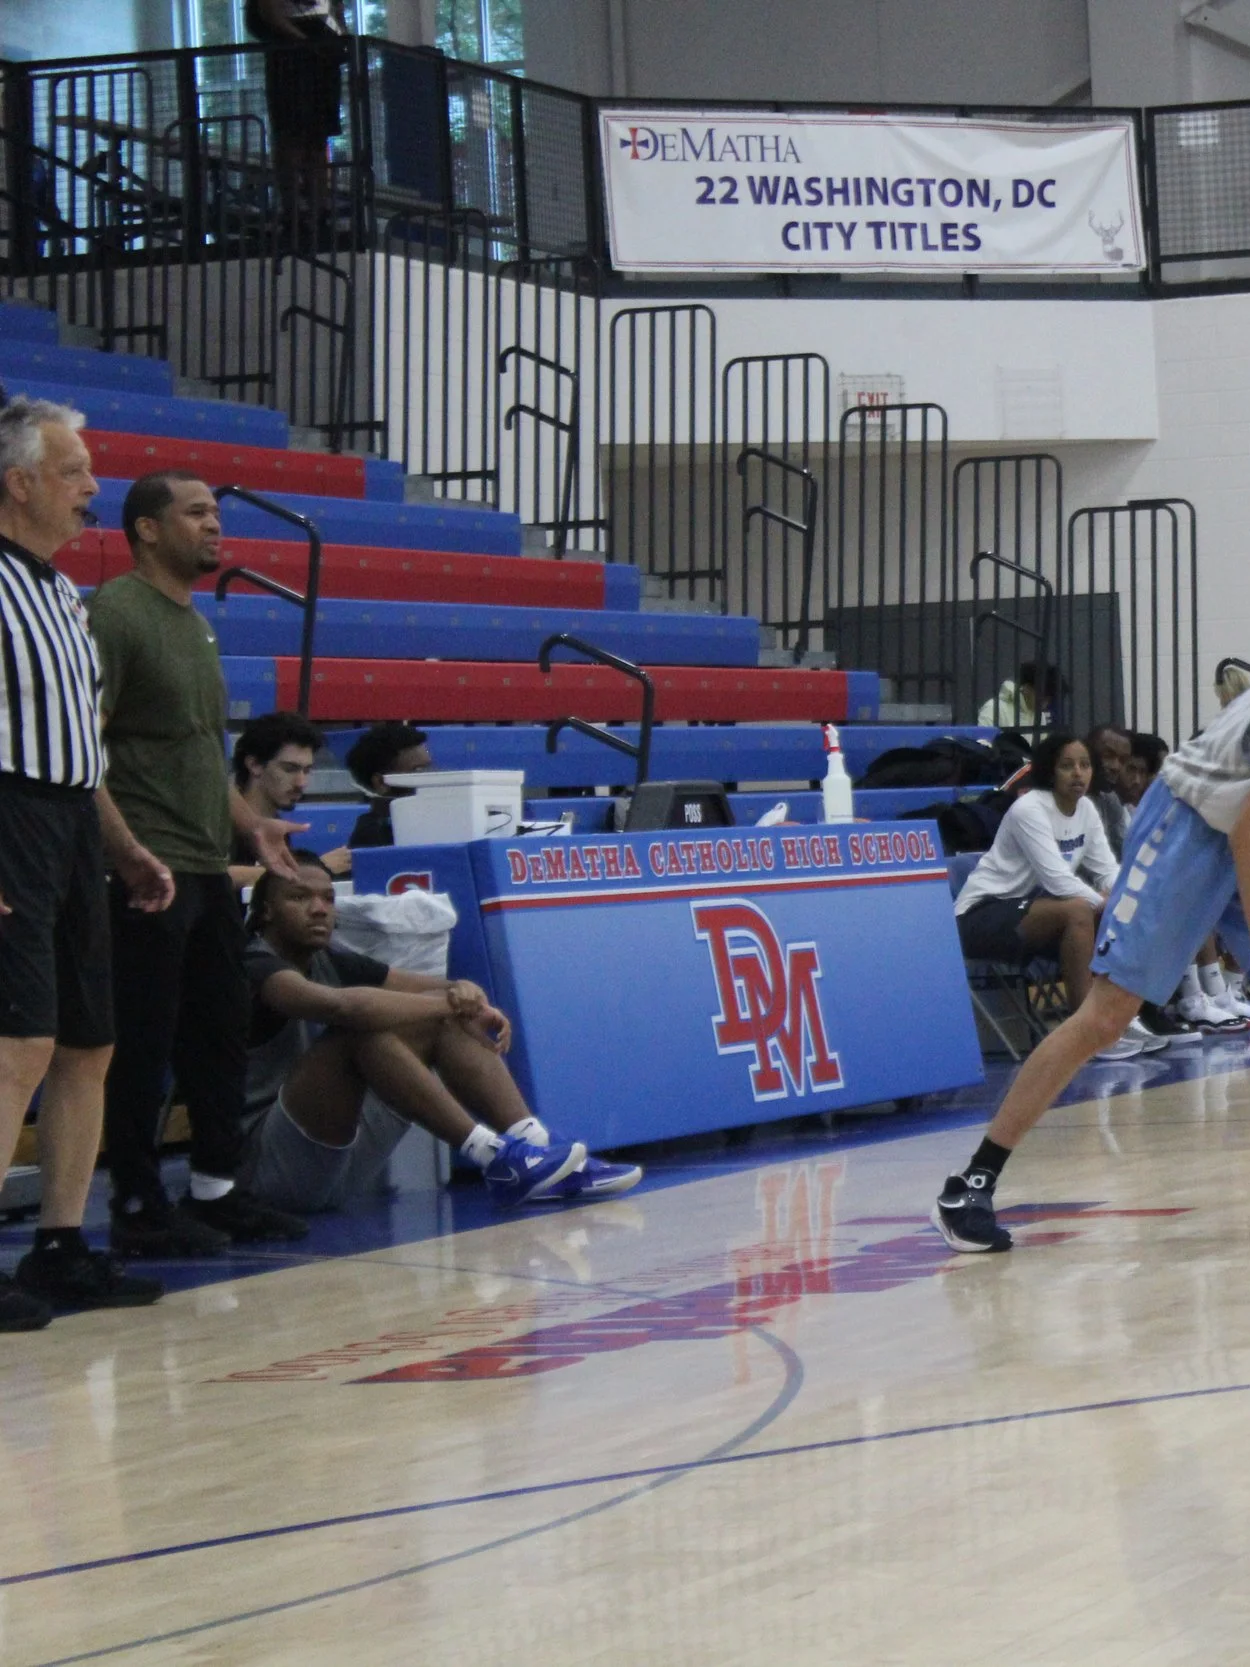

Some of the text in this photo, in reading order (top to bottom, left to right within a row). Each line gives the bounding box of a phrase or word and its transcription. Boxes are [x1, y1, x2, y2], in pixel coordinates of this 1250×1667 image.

[695, 175, 1056, 212] 22 WASHINGTON, DC
[781, 221, 982, 251] CITY TITLES
[857, 391, 888, 418] EXIT
[684, 803, 702, 823] POSS
[649, 838, 775, 877] CATHOLIC
[781, 834, 844, 869] HIGH
[848, 830, 937, 866] SCHOOL
